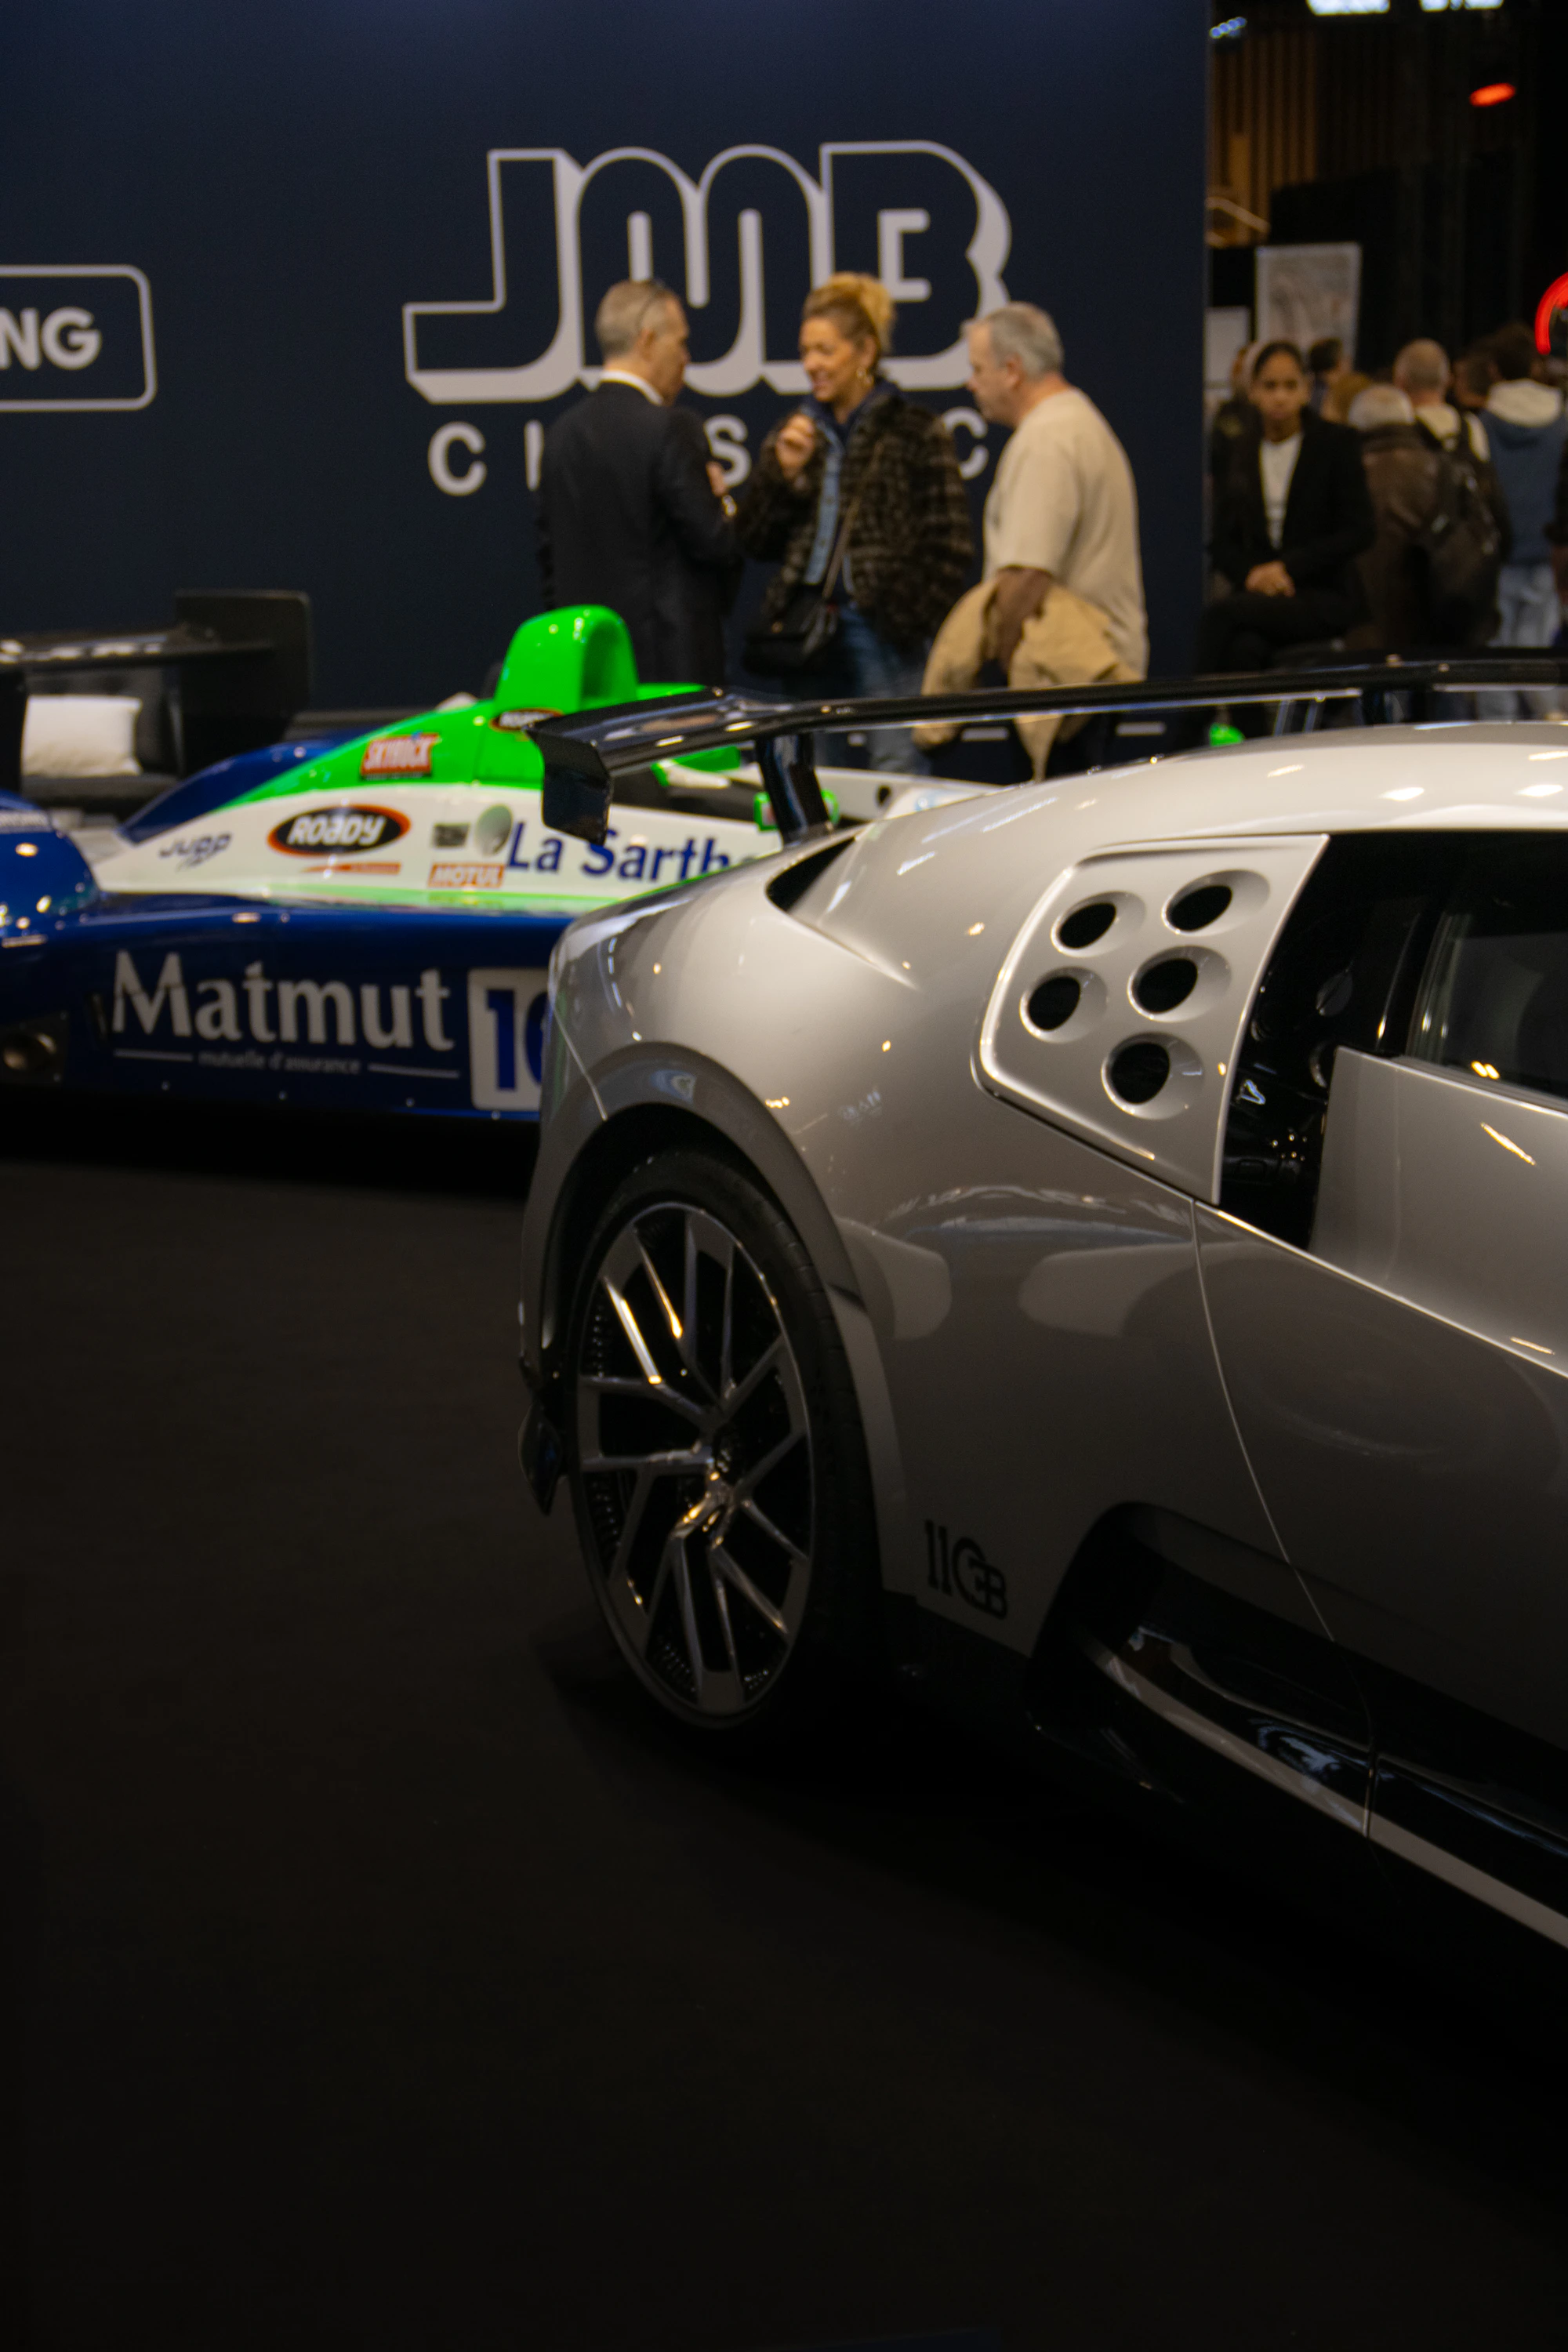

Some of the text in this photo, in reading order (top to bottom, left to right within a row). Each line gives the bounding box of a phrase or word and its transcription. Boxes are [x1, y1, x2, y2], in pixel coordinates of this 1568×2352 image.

[402, 140, 1012, 405] JMB
[433, 866, 503, 886] MOTUL
[507, 821, 757, 883] La Sarth
[111, 949, 457, 1052] Matmut
